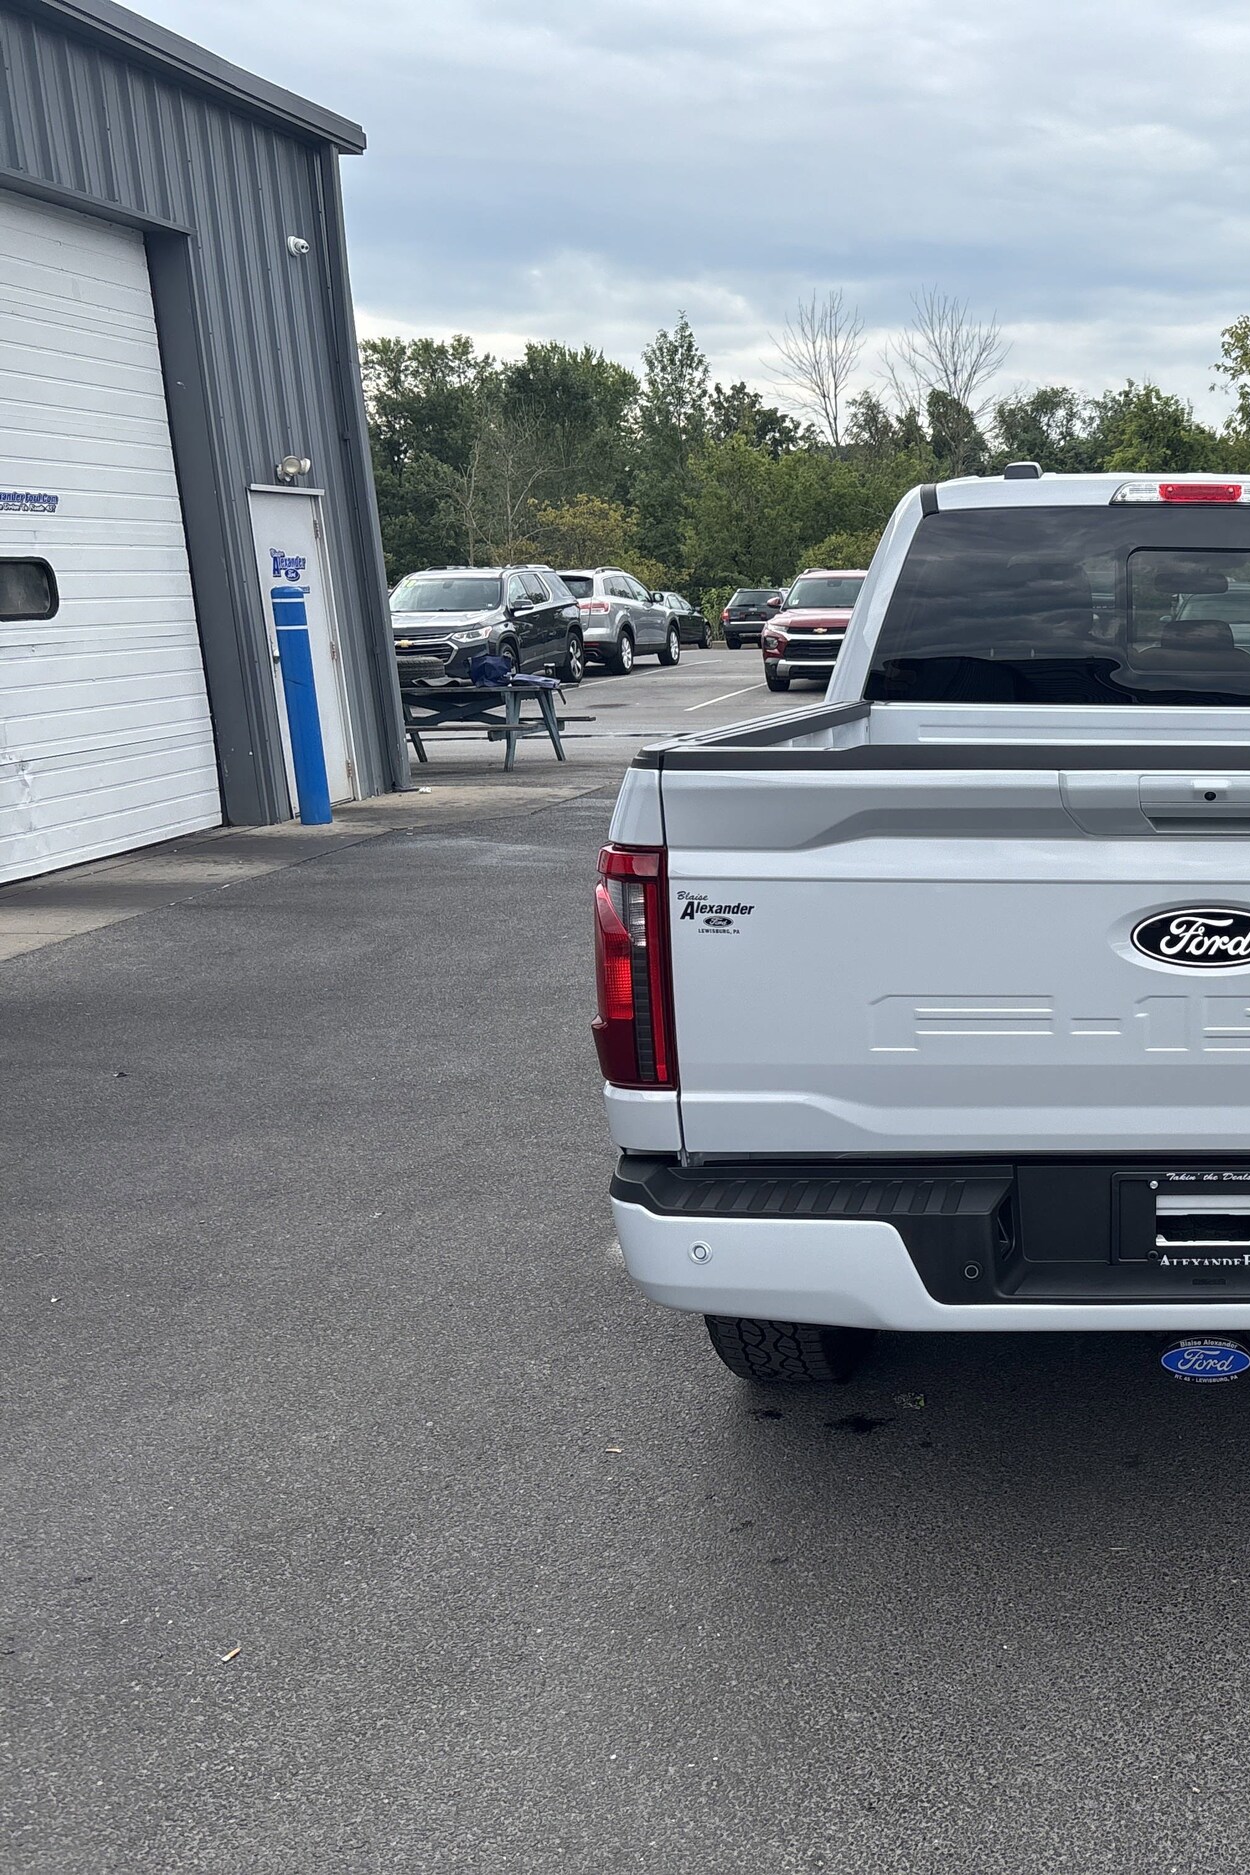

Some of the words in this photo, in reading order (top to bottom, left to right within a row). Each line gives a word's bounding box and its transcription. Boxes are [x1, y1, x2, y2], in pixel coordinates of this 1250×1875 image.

[677, 891, 708, 900] Blaise
[680, 901, 754, 919] Alexander
[709, 918, 728, 926] Ford
[1166, 1172, 1201, 1181] Takin'
[1203, 1173, 1218, 1181] the
[1180, 1340, 1202, 1348] Blaise
[1203, 1339, 1238, 1349] Alexander
[1177, 1348, 1234, 1371] Ford
